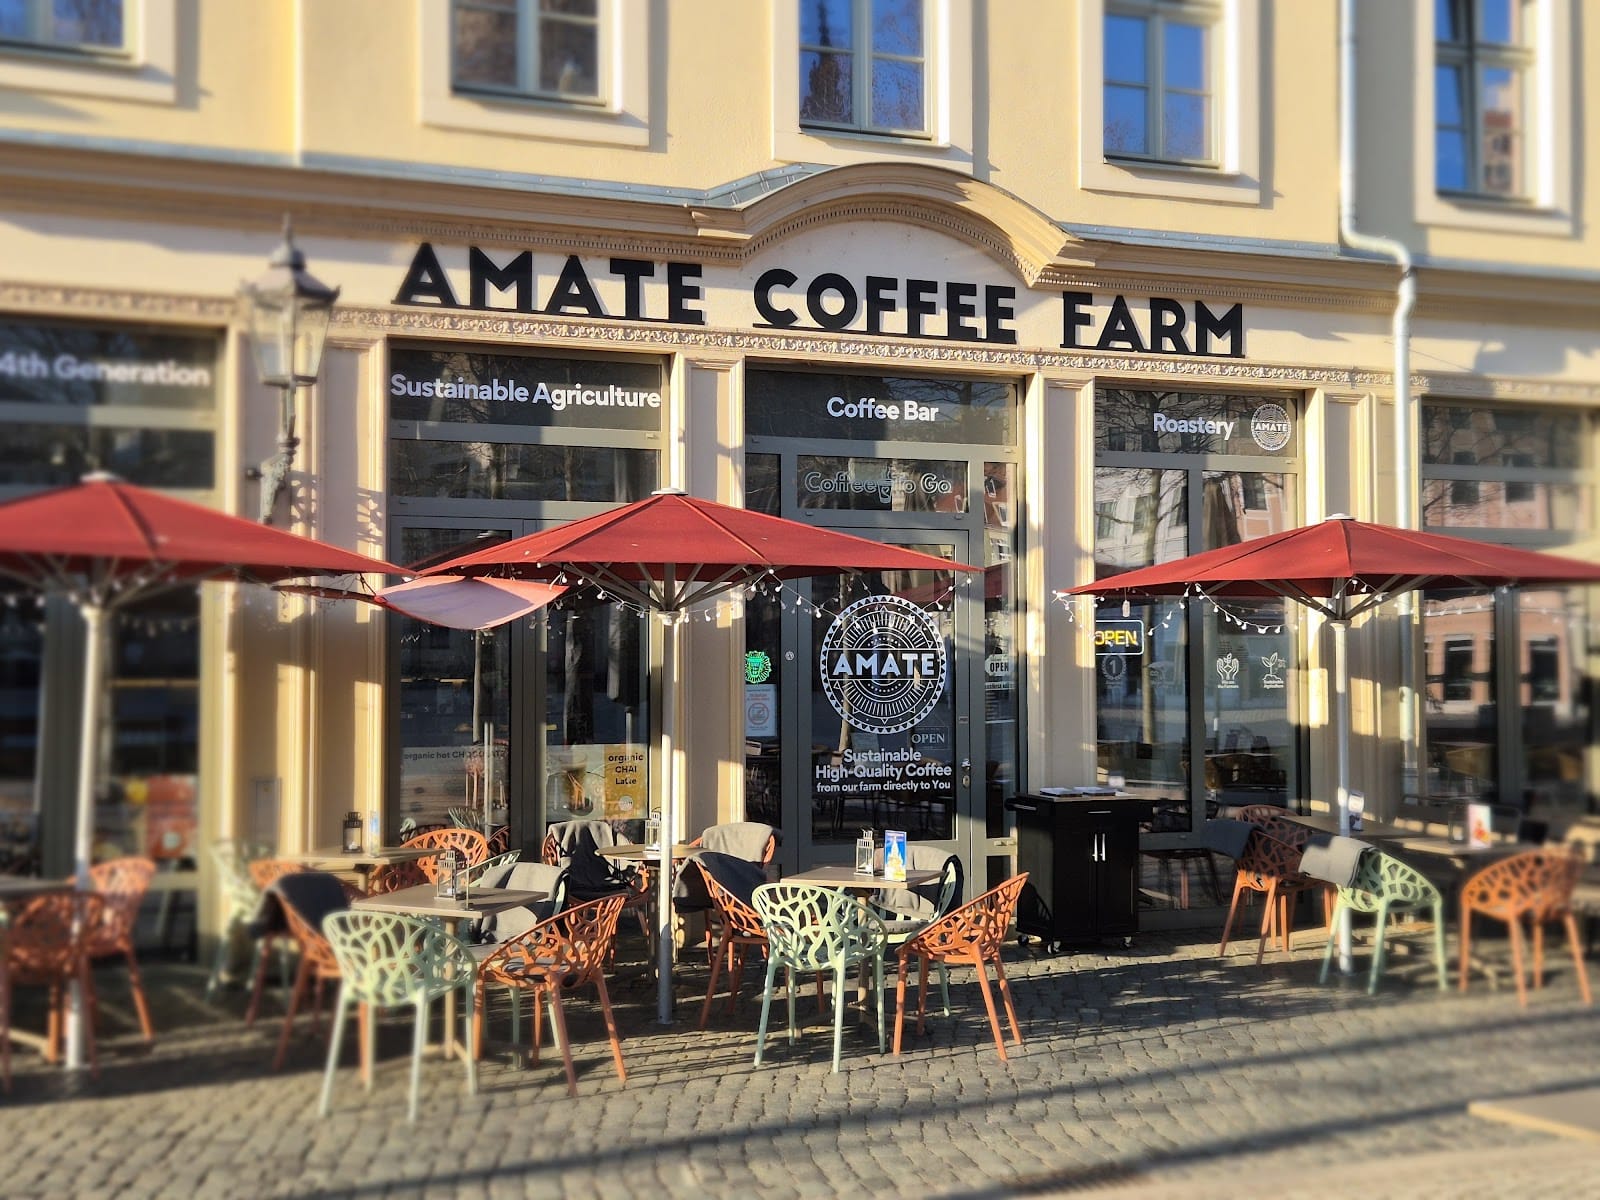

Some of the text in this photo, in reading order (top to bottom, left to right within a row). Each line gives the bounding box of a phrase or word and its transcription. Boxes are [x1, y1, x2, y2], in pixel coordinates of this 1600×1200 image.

[391, 242, 1245, 358] AMATE COFFEE FARM
[0, 352, 211, 386] 4th Generation
[390, 373, 661, 411] Sustainable Agriculture
[826, 396, 939, 422] Coffee Bar
[1153, 412, 1235, 441] Roastery
[1254, 423, 1288, 432] AMATE
[804, 471, 877, 493] Coffee
[920, 472, 951, 494] Go
[1095, 630, 1138, 645] OPEN
[832, 653, 935, 676] AMATE
[989, 662, 1009, 672] OPEN
[911, 733, 945, 744] OPEN
[403, 751, 434, 760] organic
[436, 751, 450, 759] hot
[608, 752, 644, 763] orgnic
[844, 748, 922, 763] Sustainable
[615, 765, 637, 773] CHAI
[815, 763, 952, 782] High-Quality Coffee
[816, 779, 951, 793] from our farm directly to You
